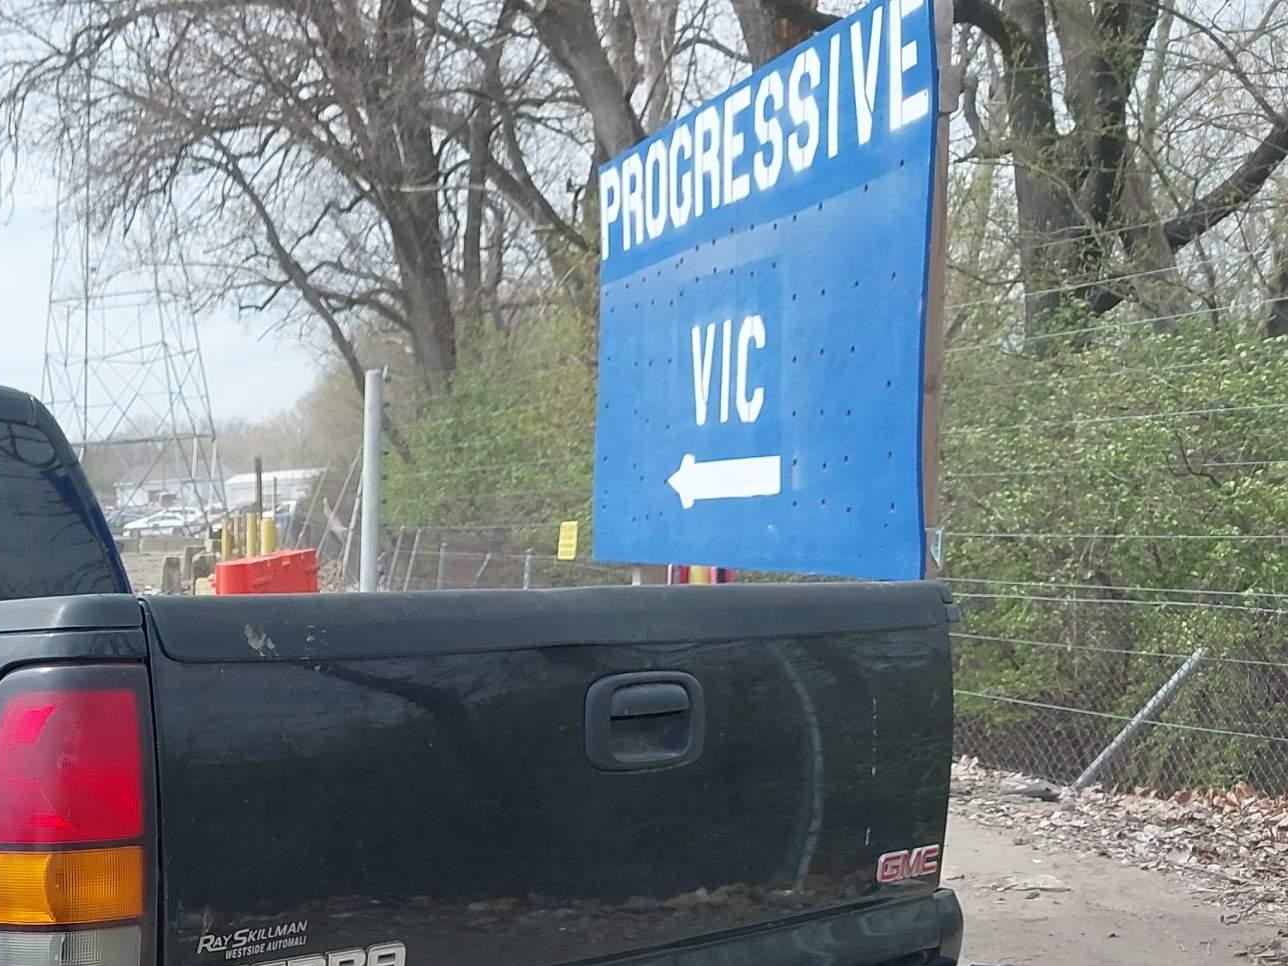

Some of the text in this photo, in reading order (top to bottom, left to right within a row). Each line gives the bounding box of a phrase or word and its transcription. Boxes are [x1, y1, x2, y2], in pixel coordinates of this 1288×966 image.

[600, 0, 929, 261] PROGRESSIVE
[692, 314, 766, 426] VIC
[877, 844, 940, 882] GMC
[225, 943, 266, 960] WESTSIDE
